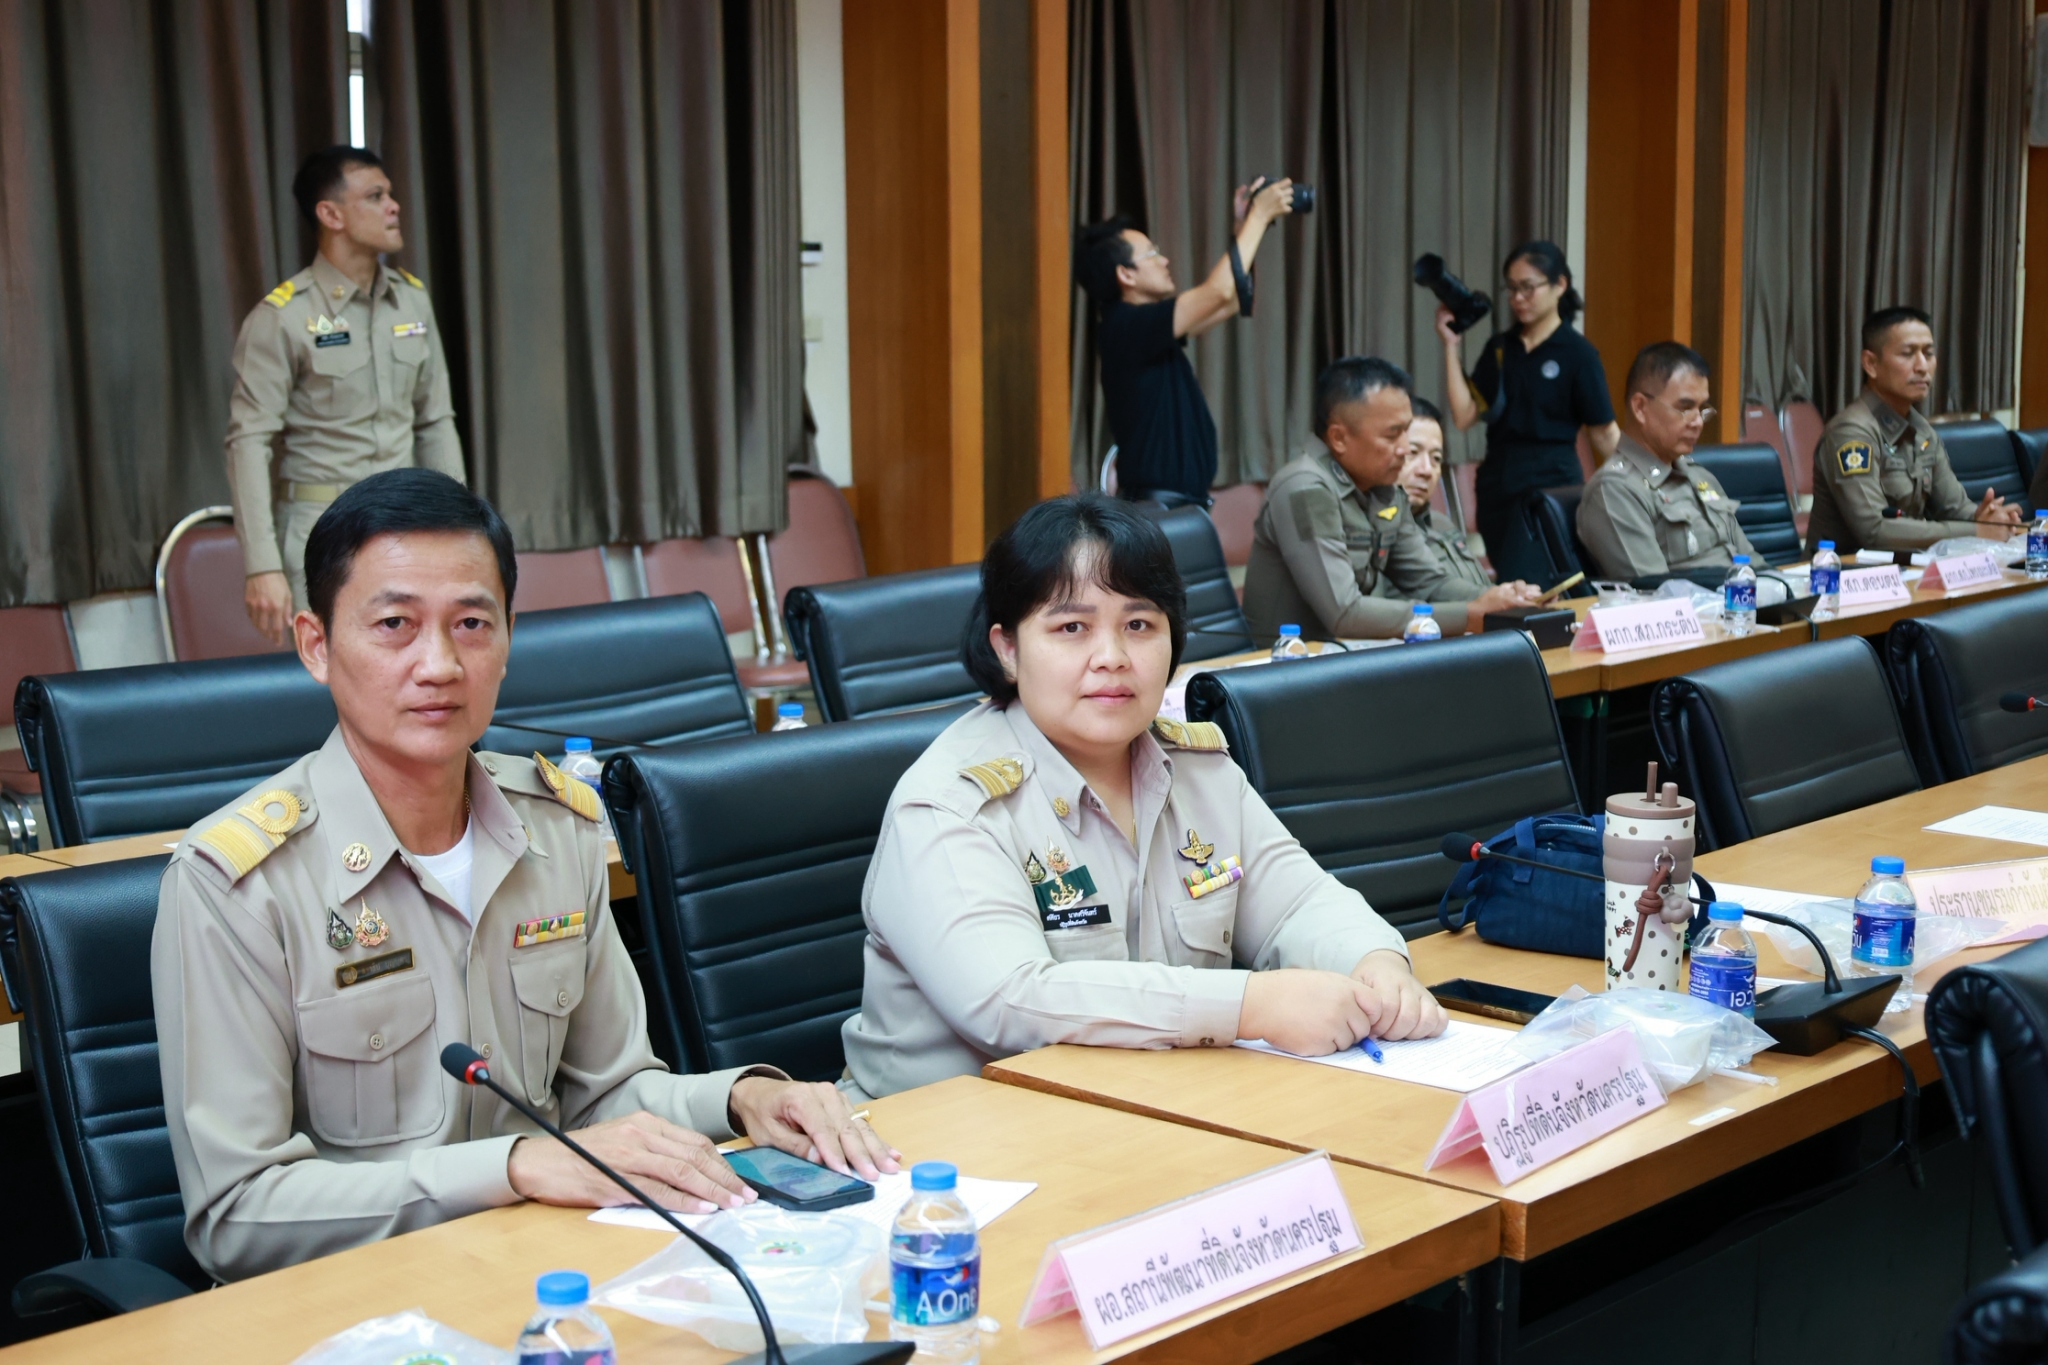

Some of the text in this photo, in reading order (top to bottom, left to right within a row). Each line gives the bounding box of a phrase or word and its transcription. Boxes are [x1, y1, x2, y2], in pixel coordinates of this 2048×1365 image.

[1841, 574, 1900, 596] .สภ.ดอนตูม
[1494, 1066, 1648, 1168] ปฏิรูปที่ดินจังหวัดนครปฐม
[1095, 1205, 1342, 1326] ผอ.สถานีพัฒนาที่ดินจังหวัดนครปฐม
